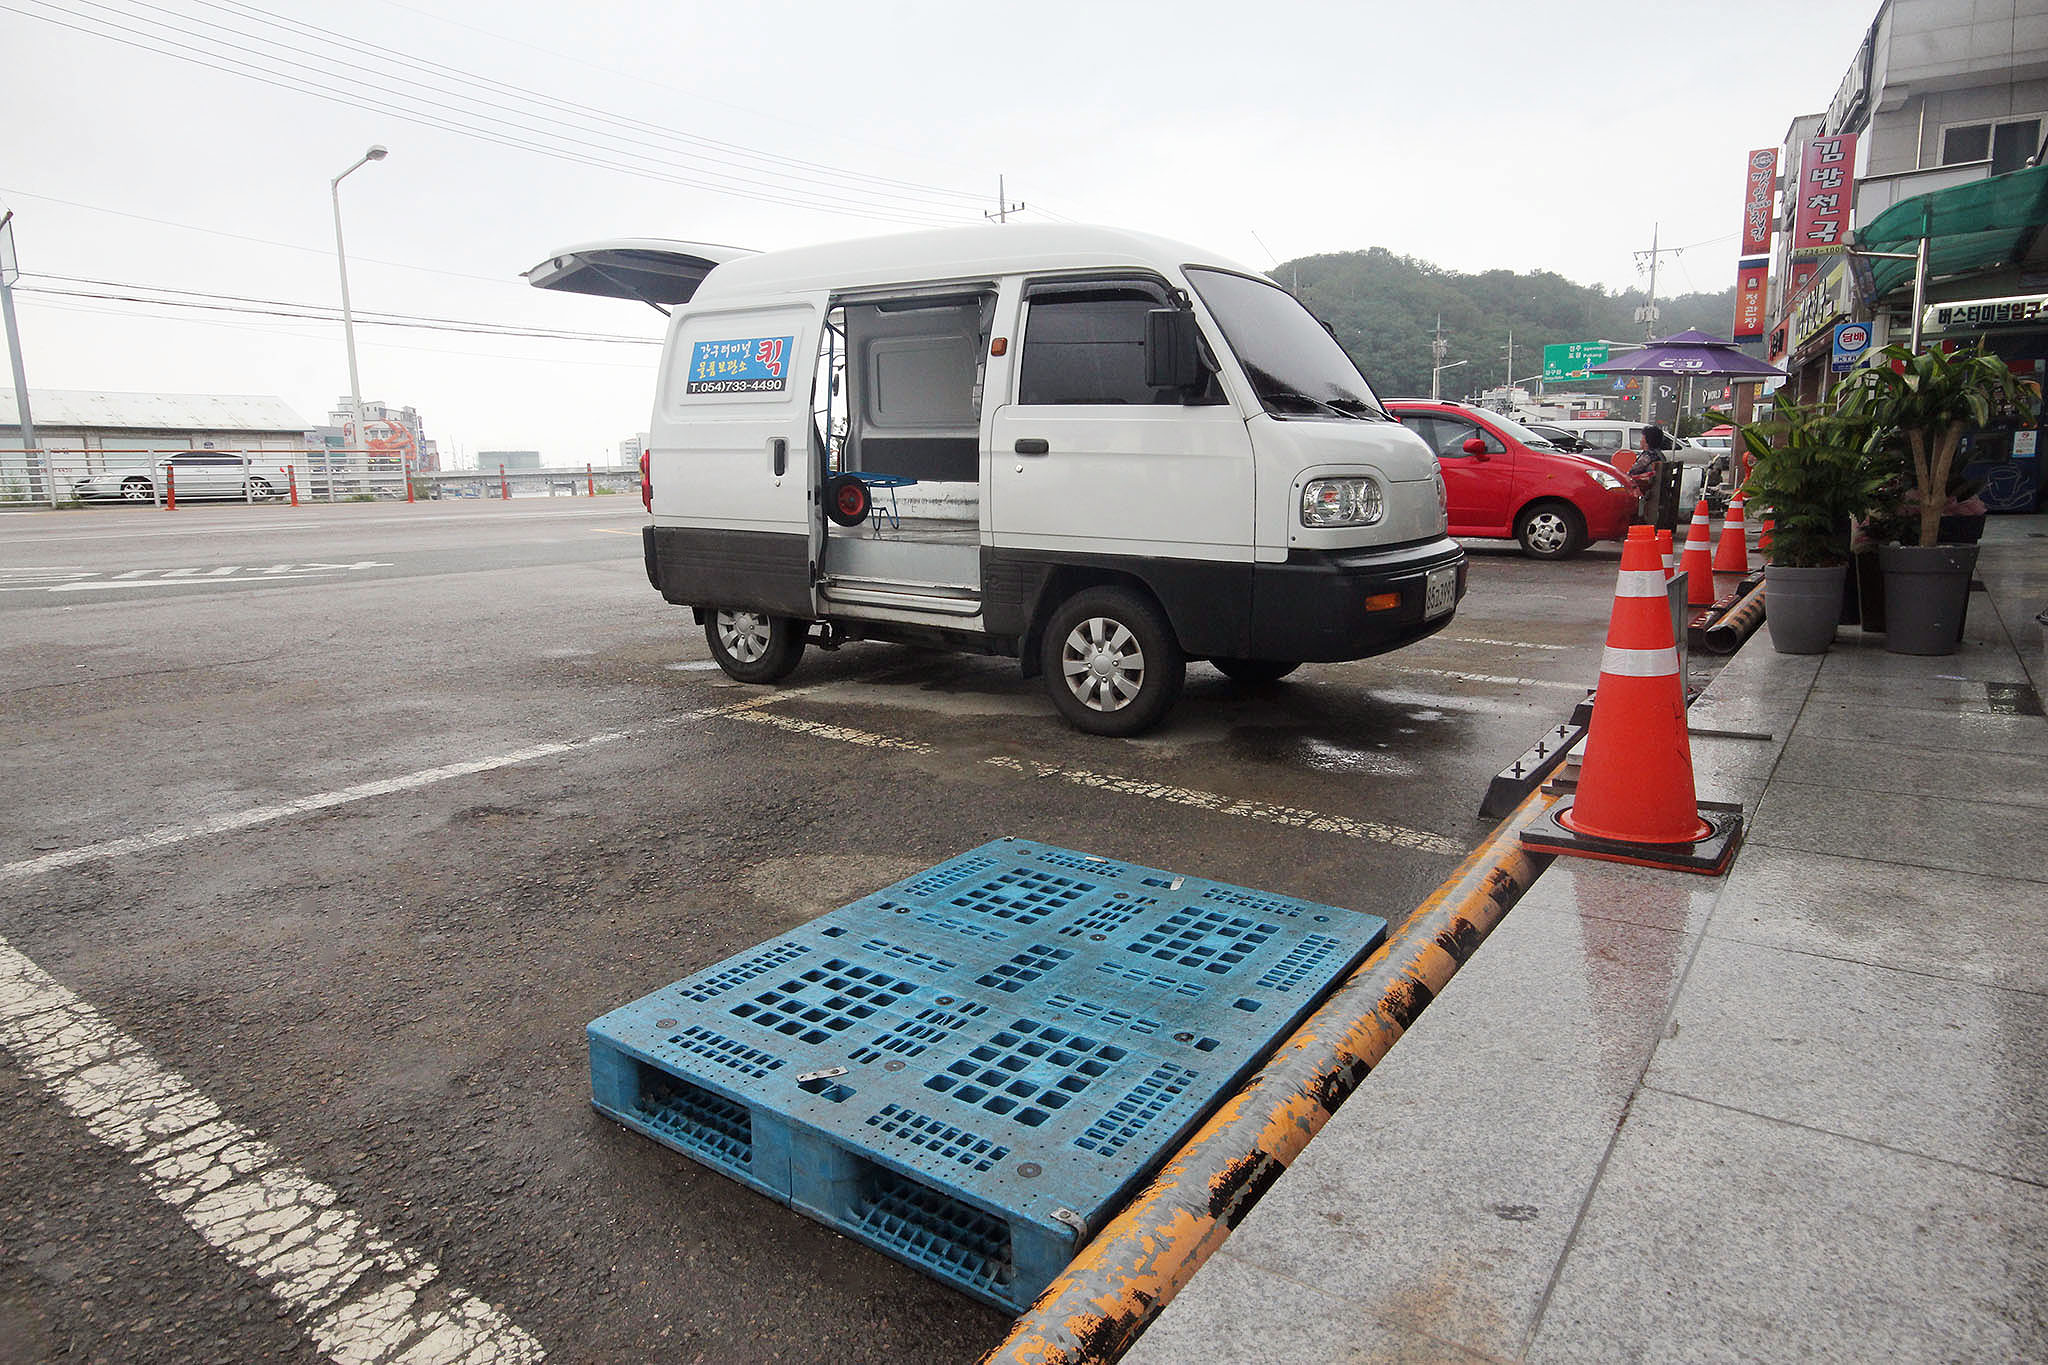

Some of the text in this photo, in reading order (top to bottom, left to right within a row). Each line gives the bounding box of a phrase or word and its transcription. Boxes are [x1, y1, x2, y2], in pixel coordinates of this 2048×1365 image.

[1807, 139, 1846, 244] 김밥천국
[1743, 292, 1759, 329] 정관장
[1938, 301, 2042, 325] 버스터미널입구
[1842, 331, 1865, 343] 담배
[700, 341, 752, 360] 강구터미널
[697, 360, 748, 379] 물품보관소
[1658, 360, 1704, 369] CU
[691, 379, 782, 393] T.054)733-4490
